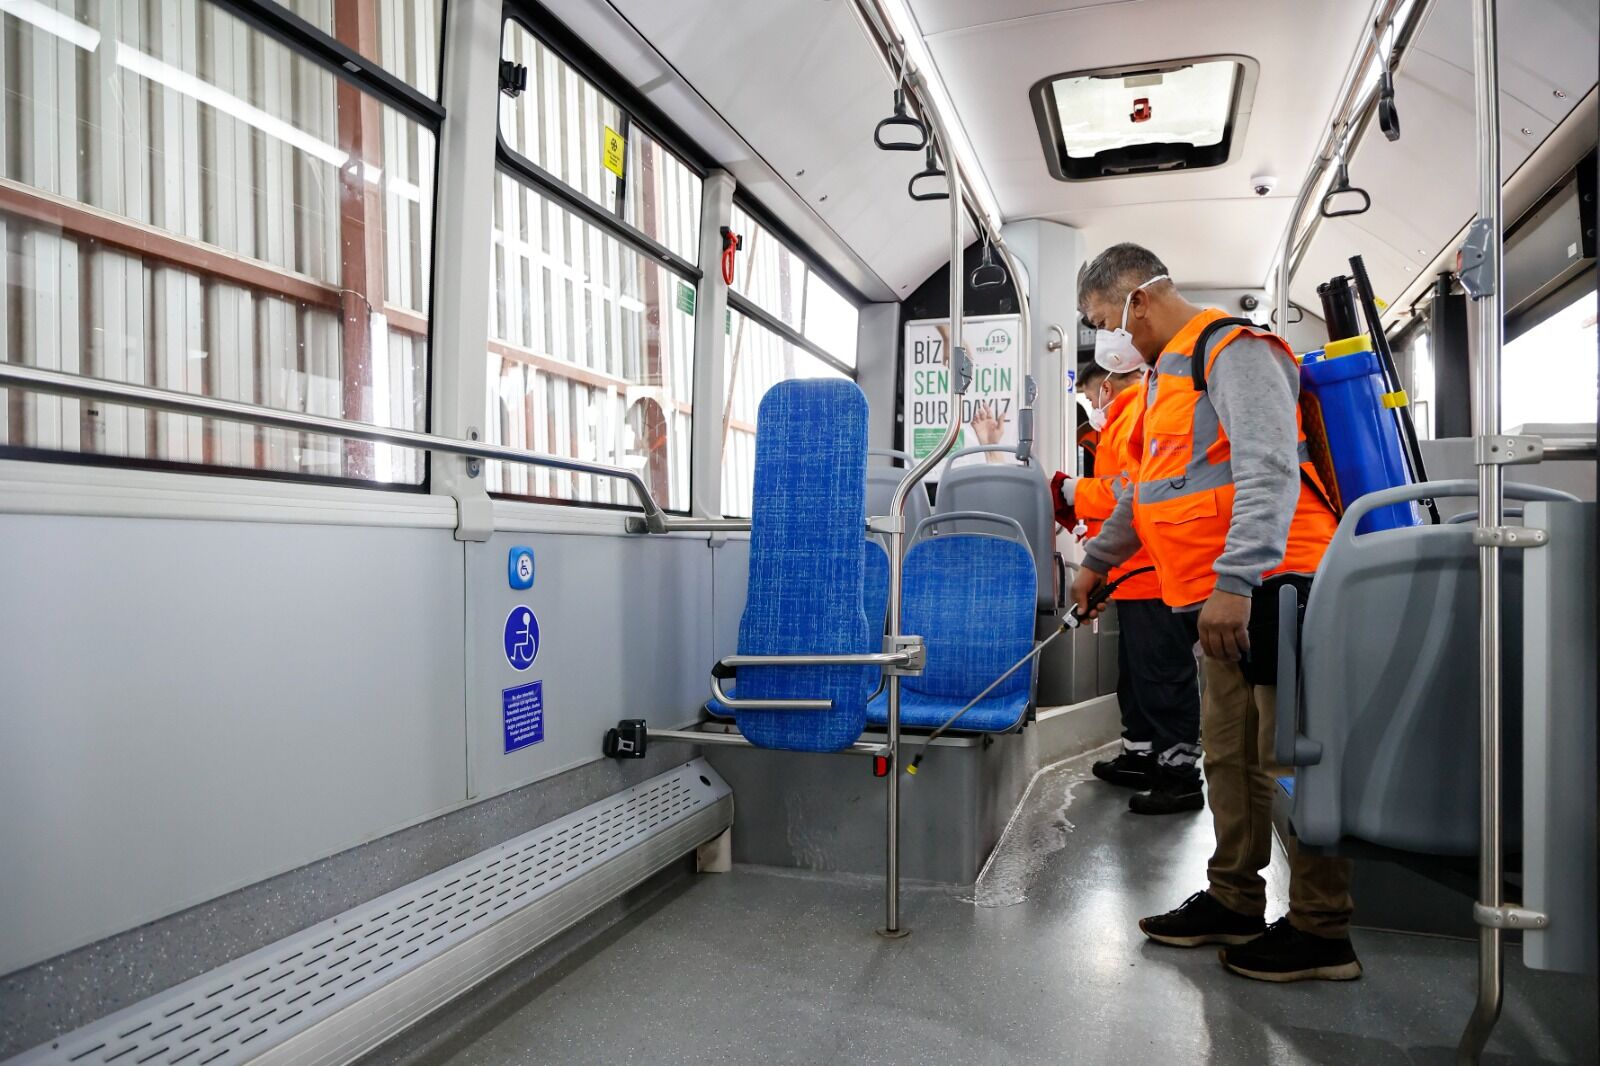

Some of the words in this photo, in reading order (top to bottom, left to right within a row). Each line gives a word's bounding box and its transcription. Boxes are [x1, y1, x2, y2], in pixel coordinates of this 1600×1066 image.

[914, 335, 942, 364] BİZ
[992, 335, 1006, 343] 115
[914, 370, 949, 395] SEN
[975, 363, 1012, 397] İÇİN
